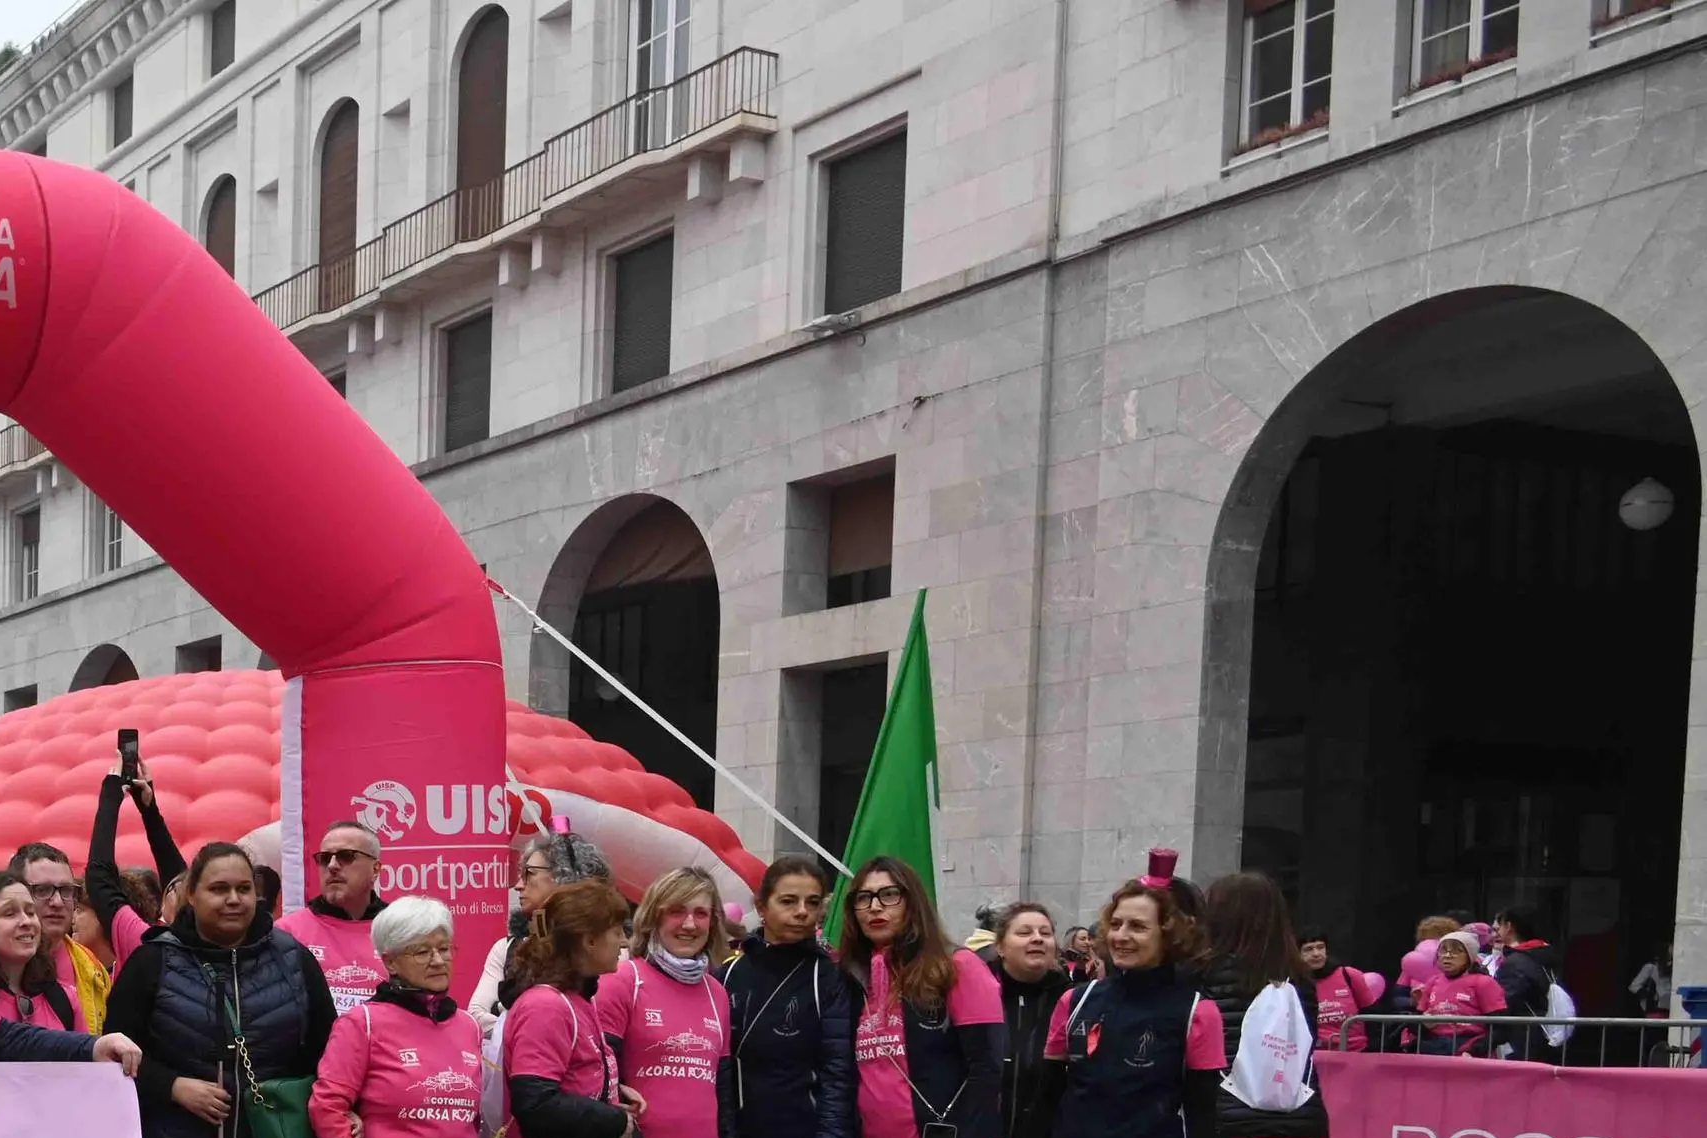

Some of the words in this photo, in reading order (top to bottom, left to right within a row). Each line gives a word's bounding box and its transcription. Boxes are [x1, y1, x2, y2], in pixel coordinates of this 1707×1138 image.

[426, 785, 510, 835] UIS
[446, 903, 467, 915] ato
[668, 1056, 711, 1067] COTONELLA
[646, 1065, 685, 1078] CORSA
[408, 1108, 450, 1121] CORSA
